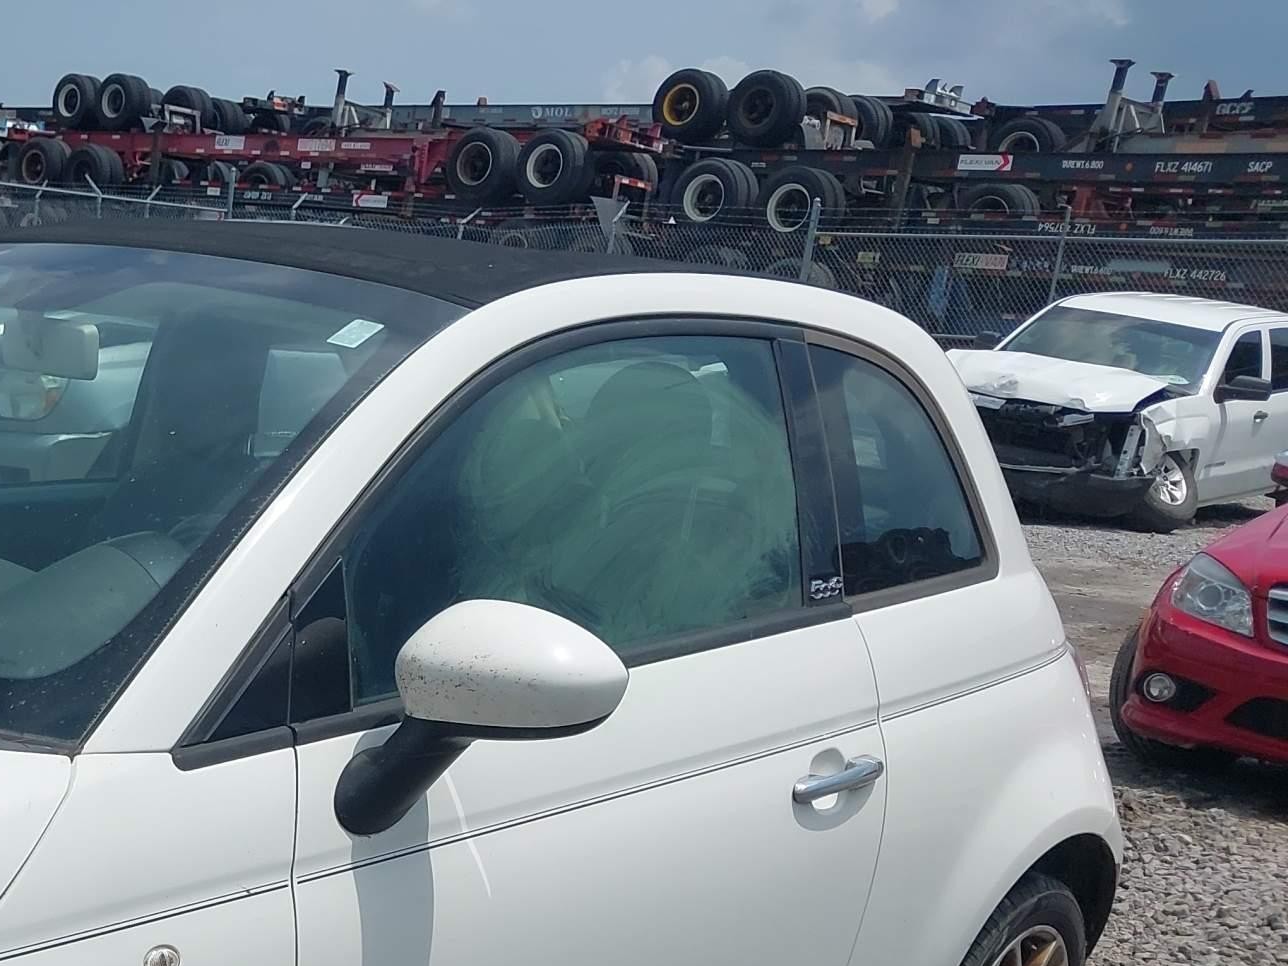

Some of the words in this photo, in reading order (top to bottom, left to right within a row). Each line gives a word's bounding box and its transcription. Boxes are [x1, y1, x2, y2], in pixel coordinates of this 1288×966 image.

[1154, 161, 1179, 173] FLXZ
[1180, 161, 1213, 173] 414671
[1247, 161, 1273, 173] SACP
